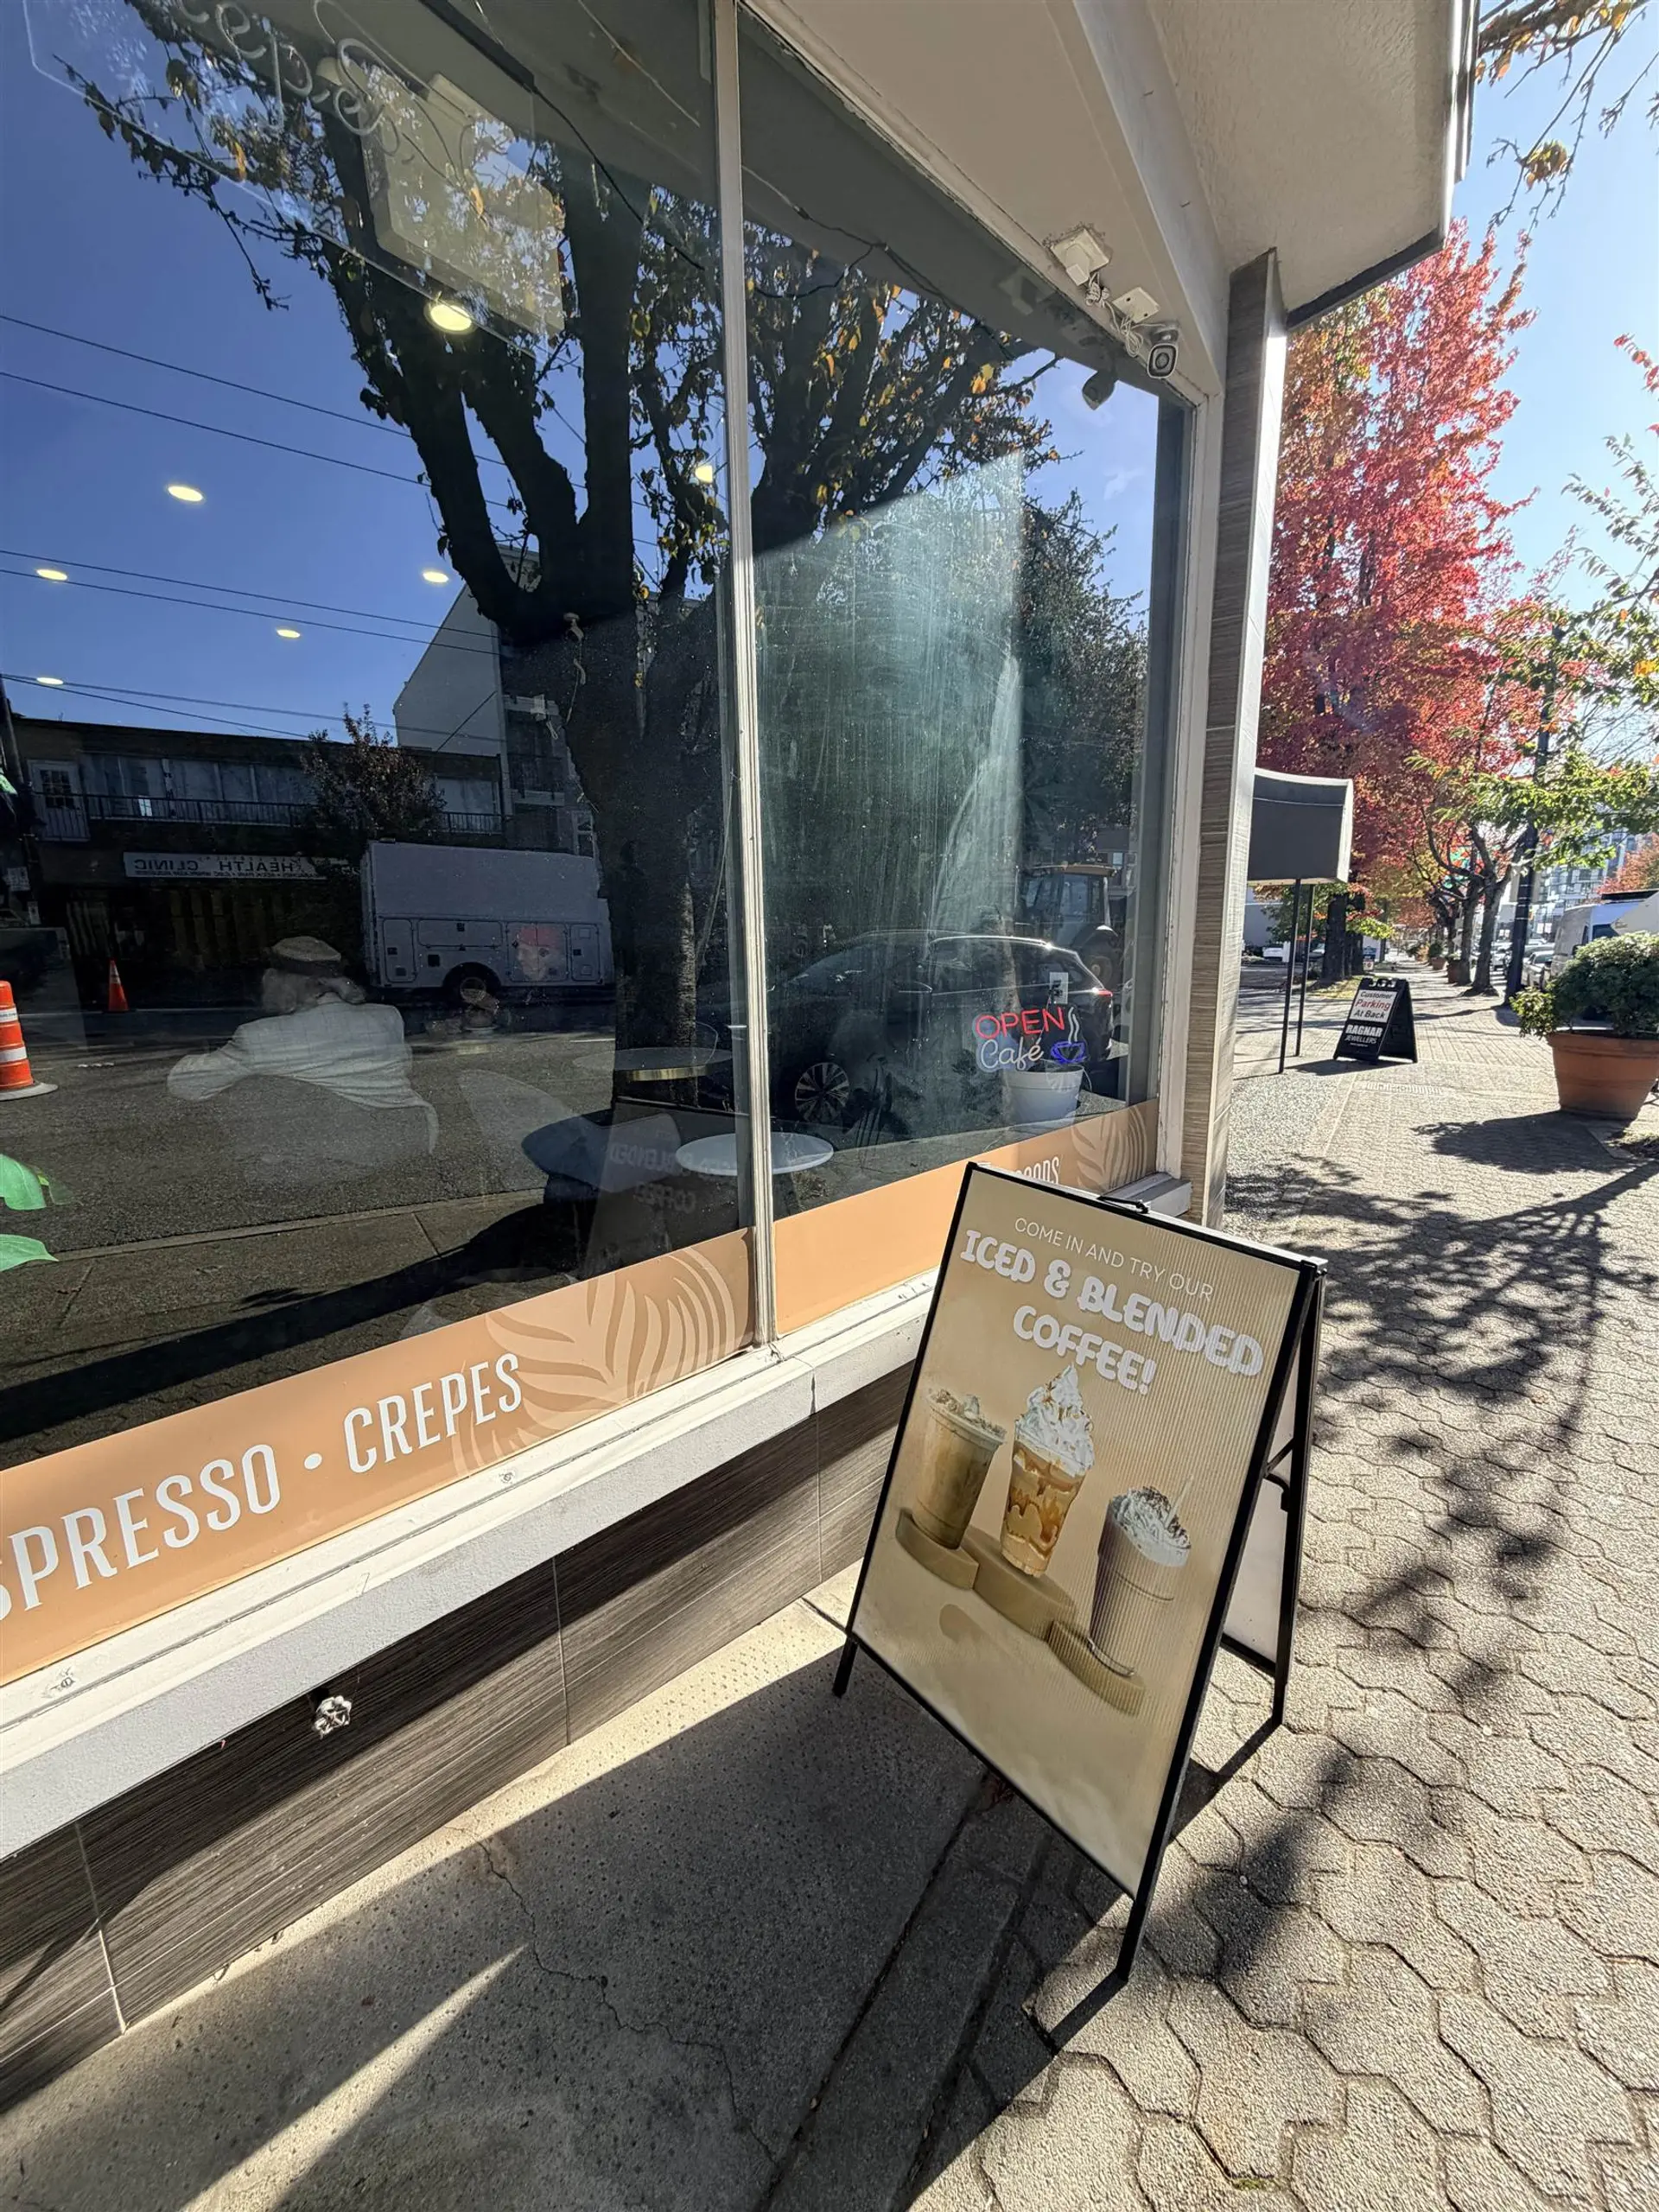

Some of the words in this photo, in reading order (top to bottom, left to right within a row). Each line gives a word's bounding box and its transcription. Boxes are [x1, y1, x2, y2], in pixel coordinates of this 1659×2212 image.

[1356, 999, 1391, 1010] Parking
[976, 1007, 1065, 1039] OPEN
[1345, 1024, 1382, 1037] RAGNAR
[1345, 1035, 1377, 1044] JEWELLERS
[979, 1037, 1045, 1071] Café
[1014, 1217, 1061, 1248] COME
[1066, 1235, 1084, 1255] IN
[1085, 1243, 1124, 1269] AND
[1129, 1256, 1166, 1282] TRY
[1169, 1273, 1214, 1301] OUR
[960, 1230, 1035, 1284] ICED
[1044, 1259, 1071, 1299] &
[1077, 1275, 1265, 1377] BLENDED
[1014, 1304, 1157, 1396] COFFEE!
[0, 1444, 282, 1621] PRESSO
[344, 1353, 524, 1473] CREPES
